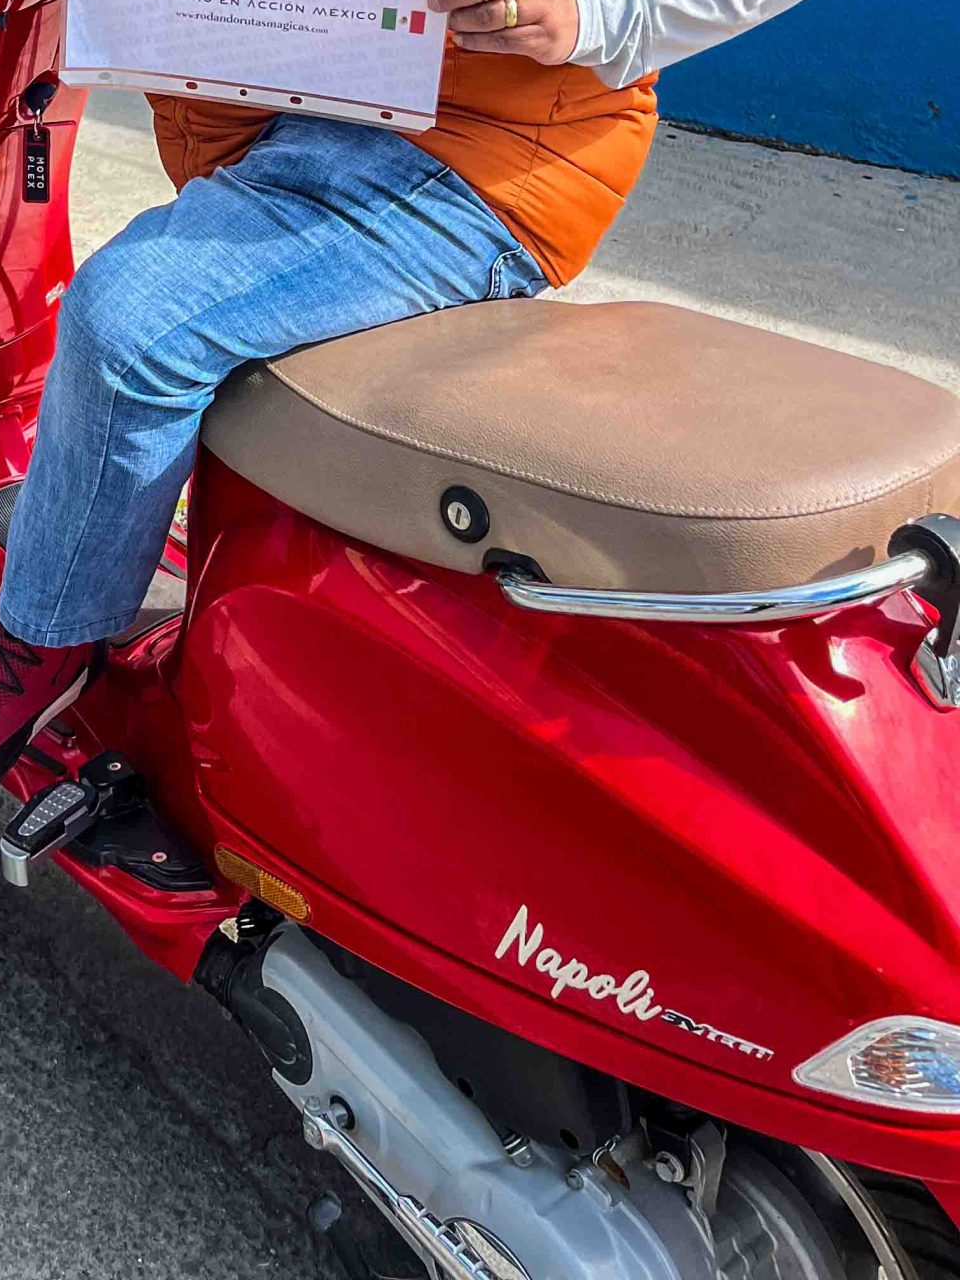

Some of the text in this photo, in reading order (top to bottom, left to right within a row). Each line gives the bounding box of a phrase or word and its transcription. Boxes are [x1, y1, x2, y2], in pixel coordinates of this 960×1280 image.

[176, 11, 328, 34] www.rodandorutasmagicas.com
[27, 156, 35, 188] PLEX
[36, 156, 45, 189] MOTO
[495, 904, 662, 1021] Napoli
